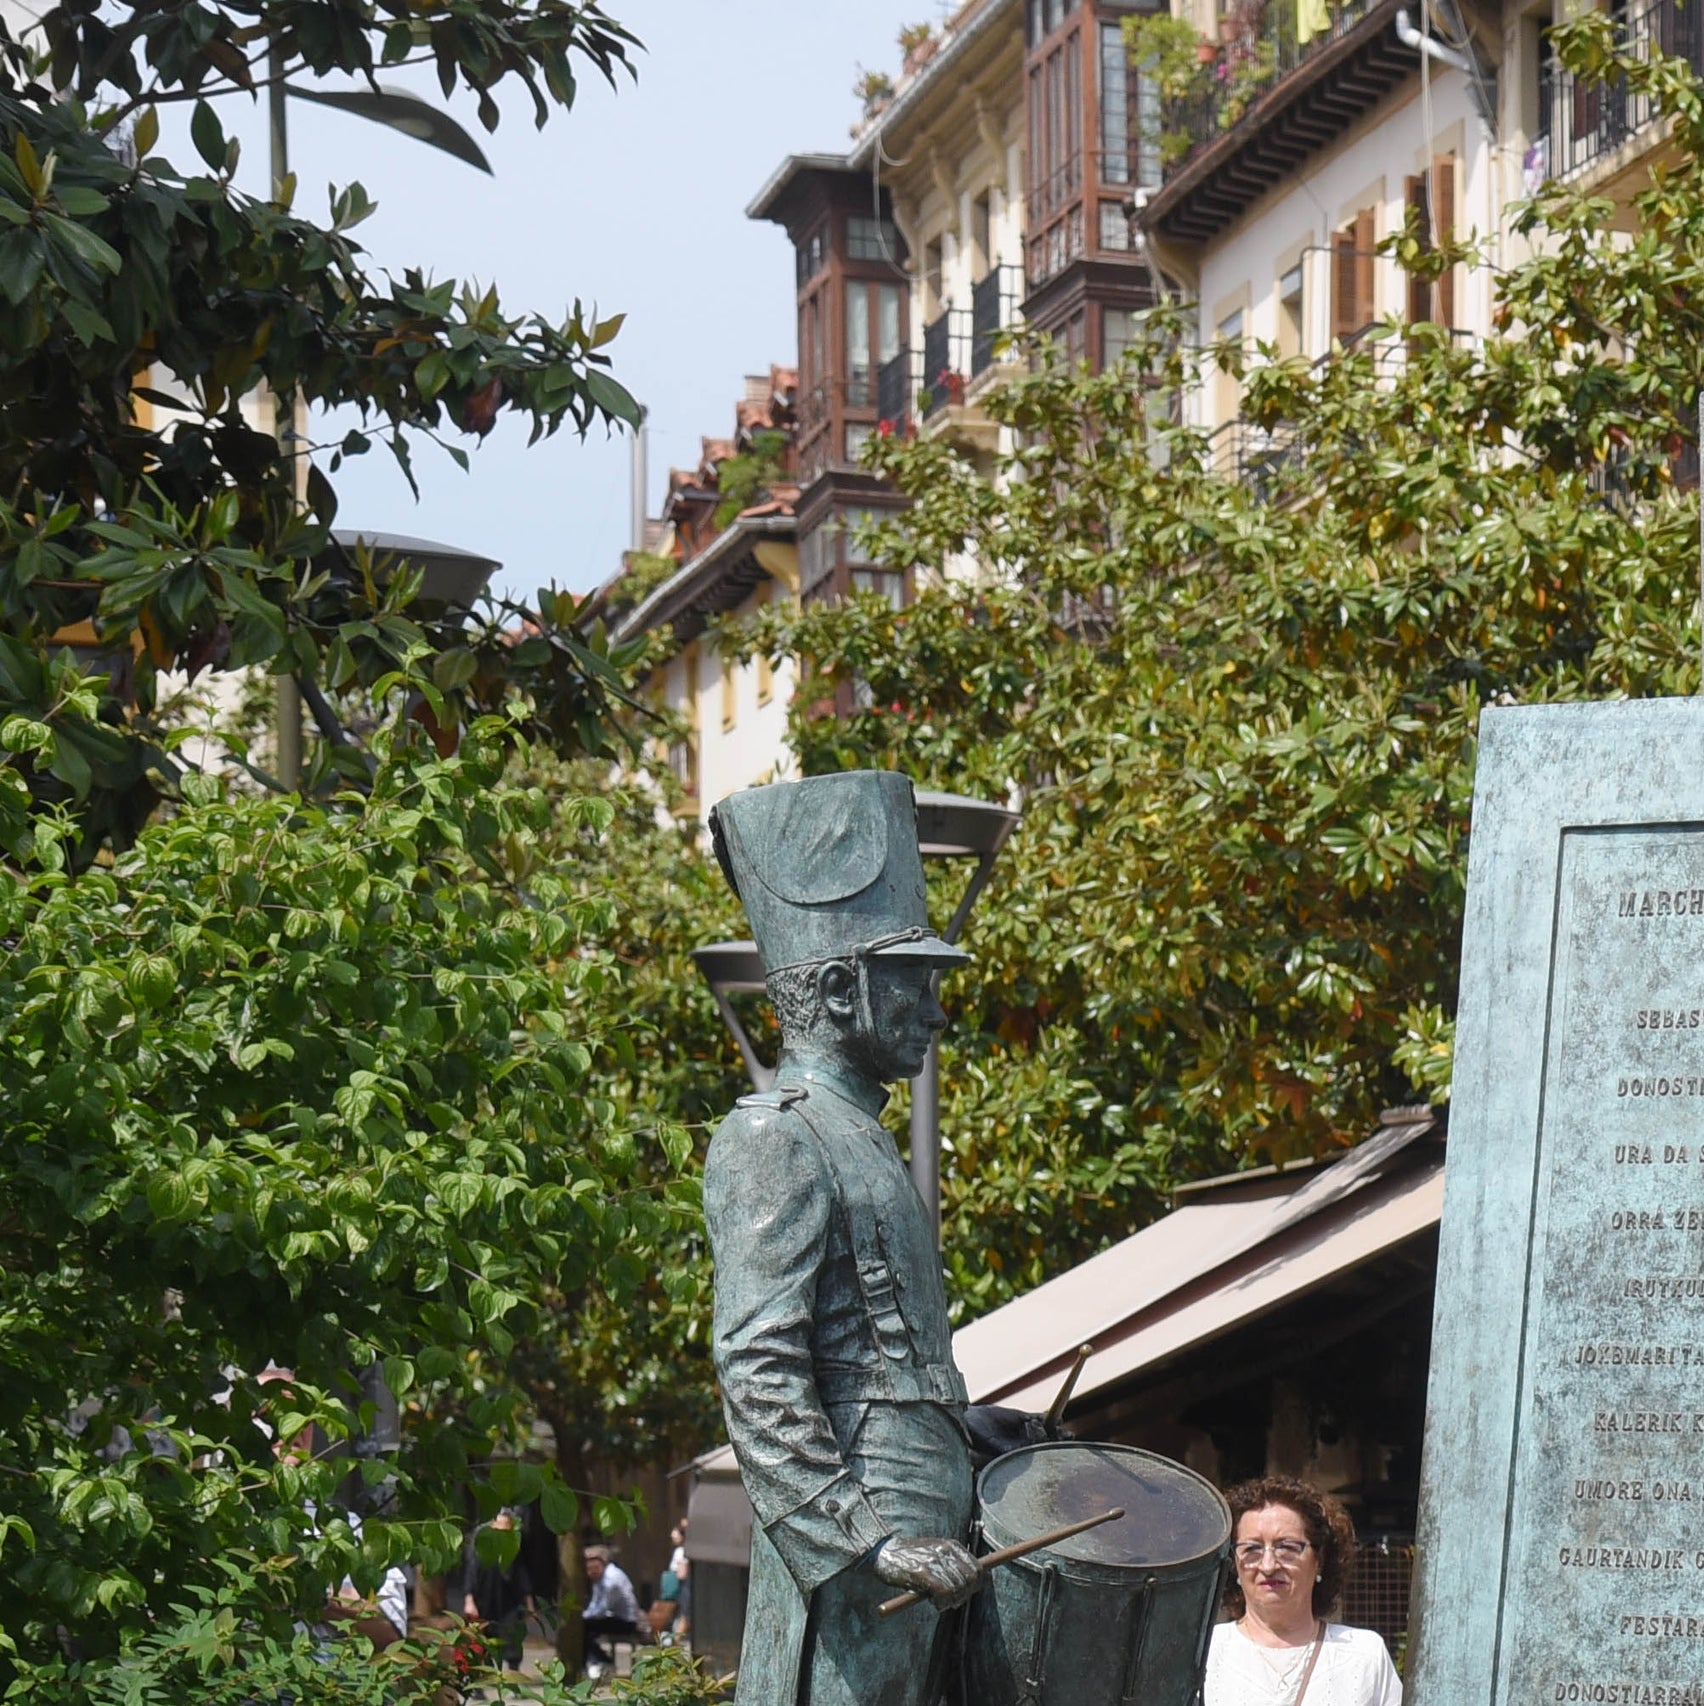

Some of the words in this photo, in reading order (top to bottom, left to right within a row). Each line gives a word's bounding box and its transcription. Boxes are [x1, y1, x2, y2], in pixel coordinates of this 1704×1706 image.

[1614, 1143, 1653, 1164] URA
[1664, 1143, 1689, 1164] DA
[1594, 1411, 1682, 1432] KALERIK
[1574, 1480, 1643, 1501] UMORE
[1652, 1482, 1692, 1502] ONA
[1558, 1547, 1684, 1570] GAURTANDIK
